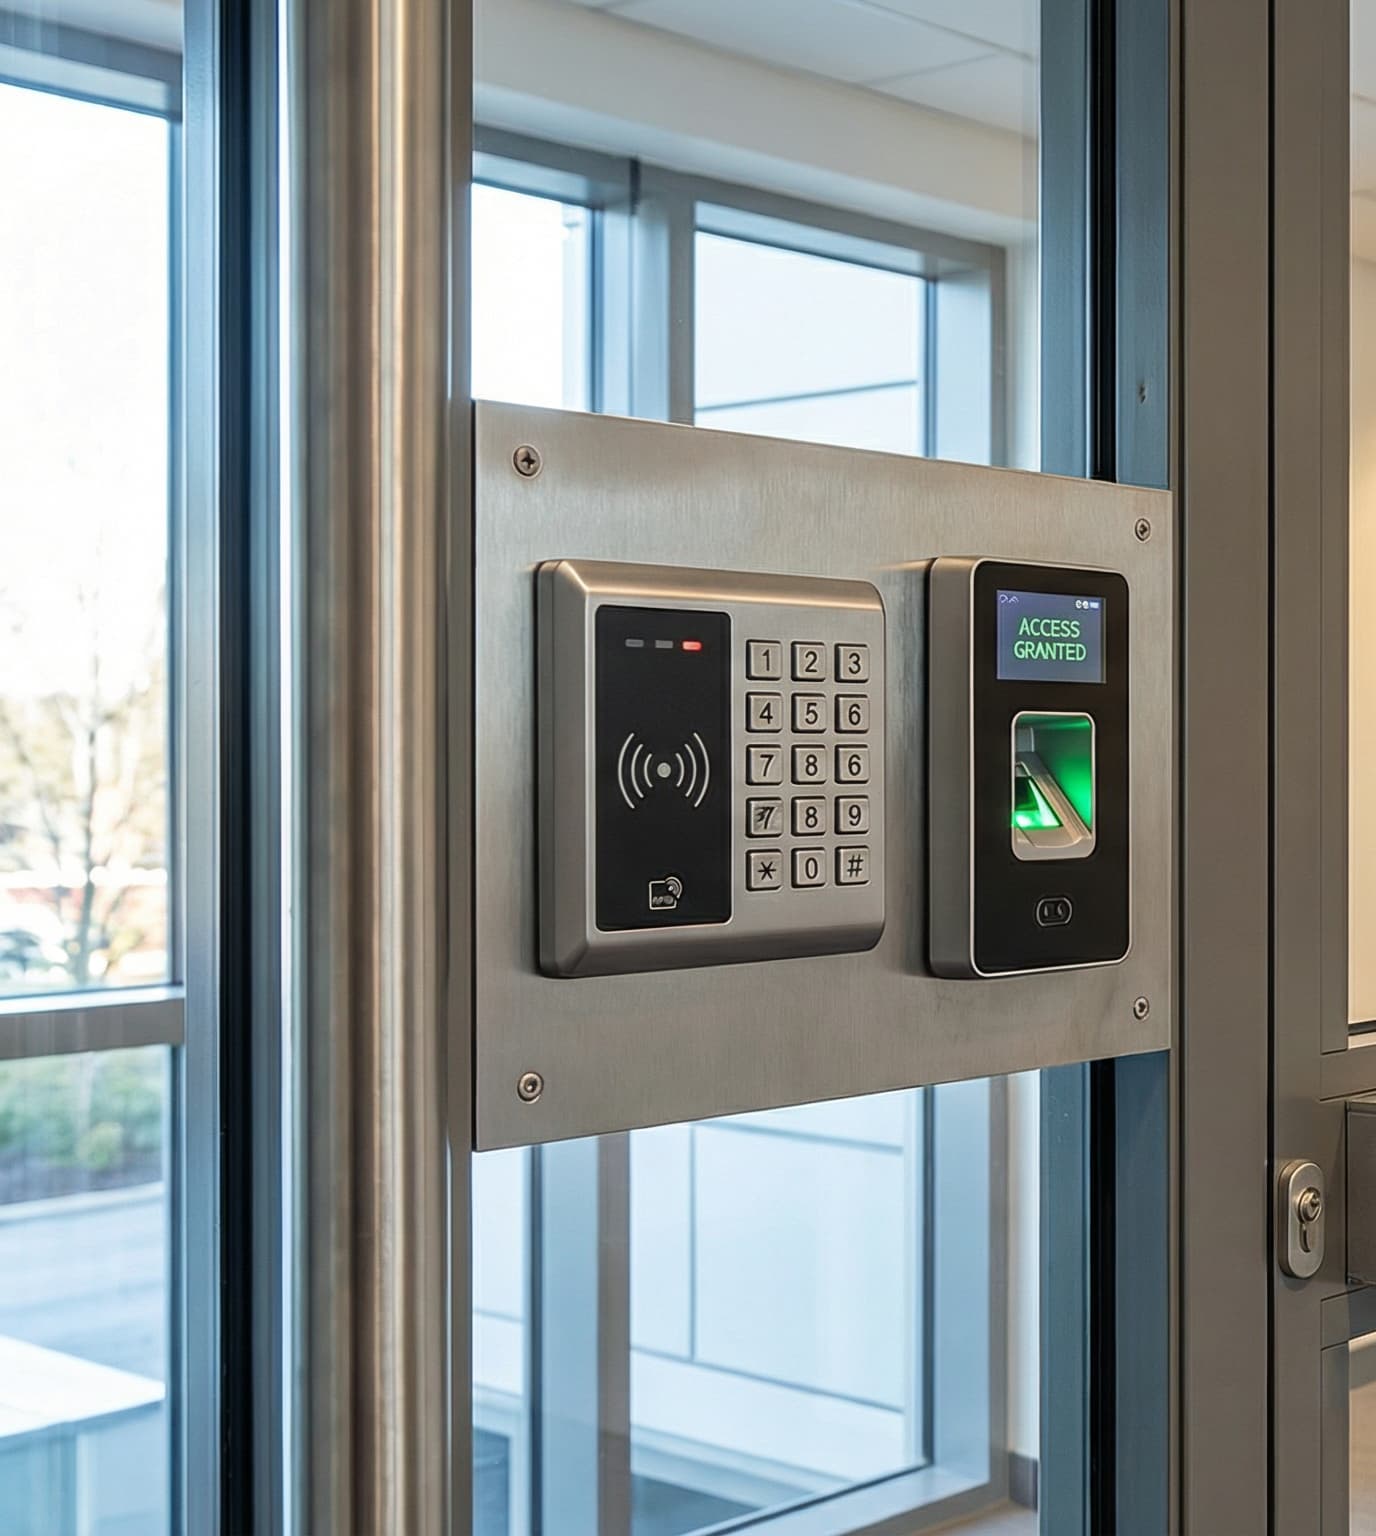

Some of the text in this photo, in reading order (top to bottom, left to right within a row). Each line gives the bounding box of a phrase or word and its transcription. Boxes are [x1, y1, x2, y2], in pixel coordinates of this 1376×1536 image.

[1019, 617, 1080, 638] ACCESS
[762, 649, 861, 674] 1 2 3
[1014, 640, 1087, 661] GRANTED
[759, 702, 861, 726] 4 5 6
[760, 754, 861, 777] 7 8 6
[805, 806, 818, 828] 8
[848, 804, 861, 826] 9
[805, 857, 818, 880] 0
[847, 854, 864, 877] #
